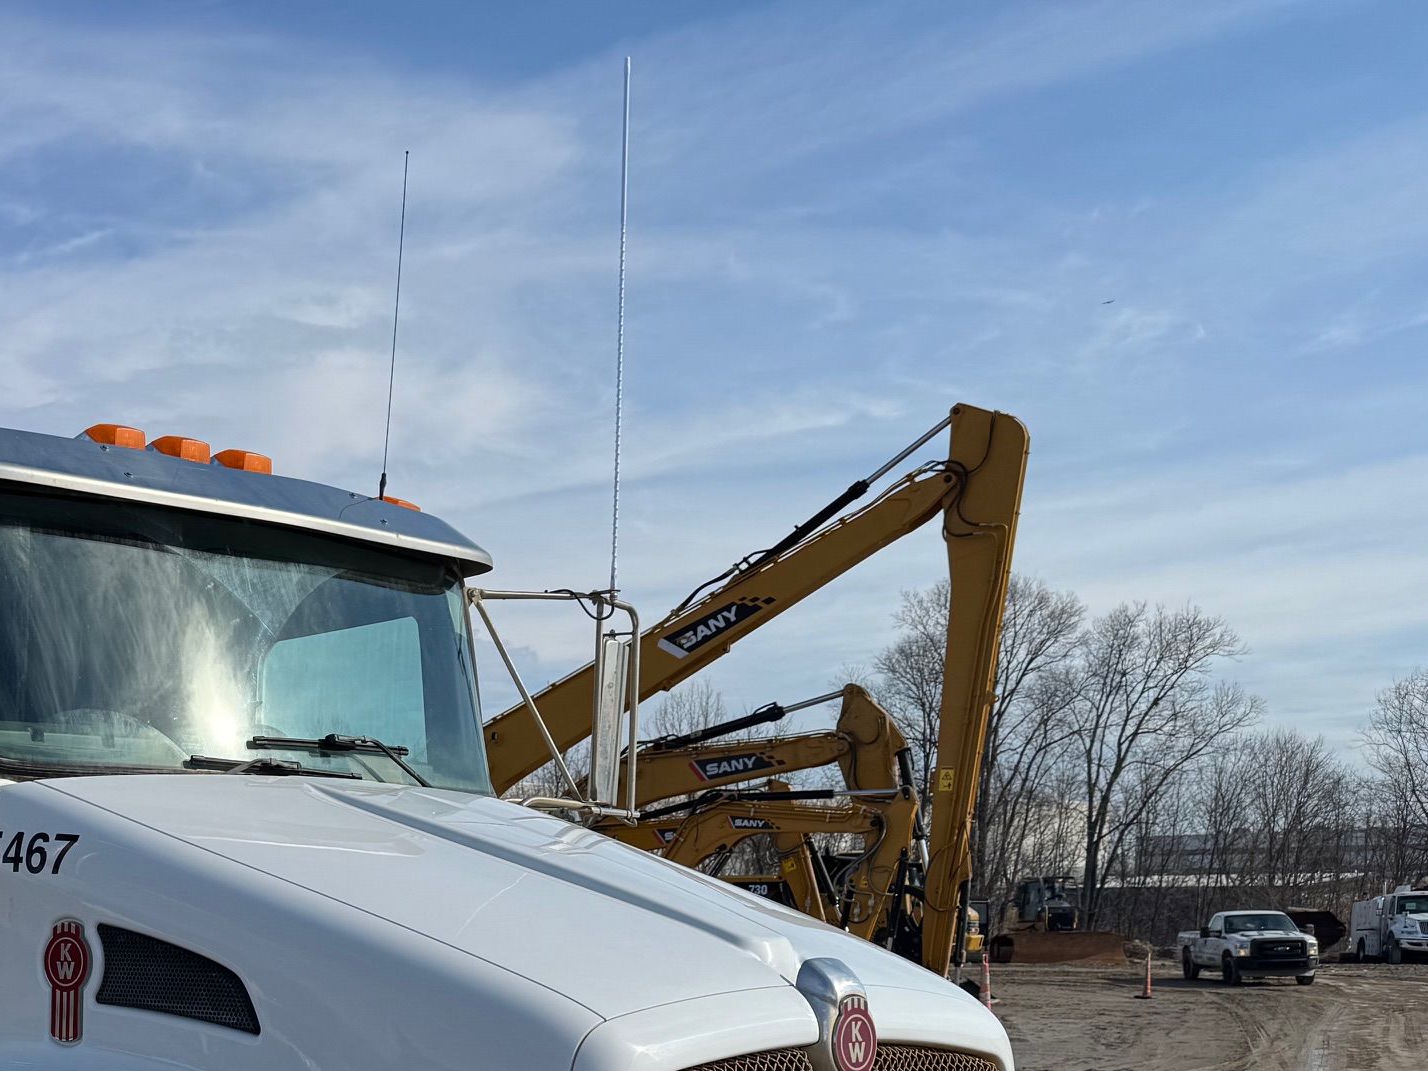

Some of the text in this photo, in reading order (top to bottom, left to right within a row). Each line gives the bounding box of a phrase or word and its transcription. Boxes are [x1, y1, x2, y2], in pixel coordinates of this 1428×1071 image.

[676, 605, 737, 649] SANY
[705, 756, 757, 776] SANY
[734, 818, 765, 828] SANY
[748, 884, 768, 895] 730
